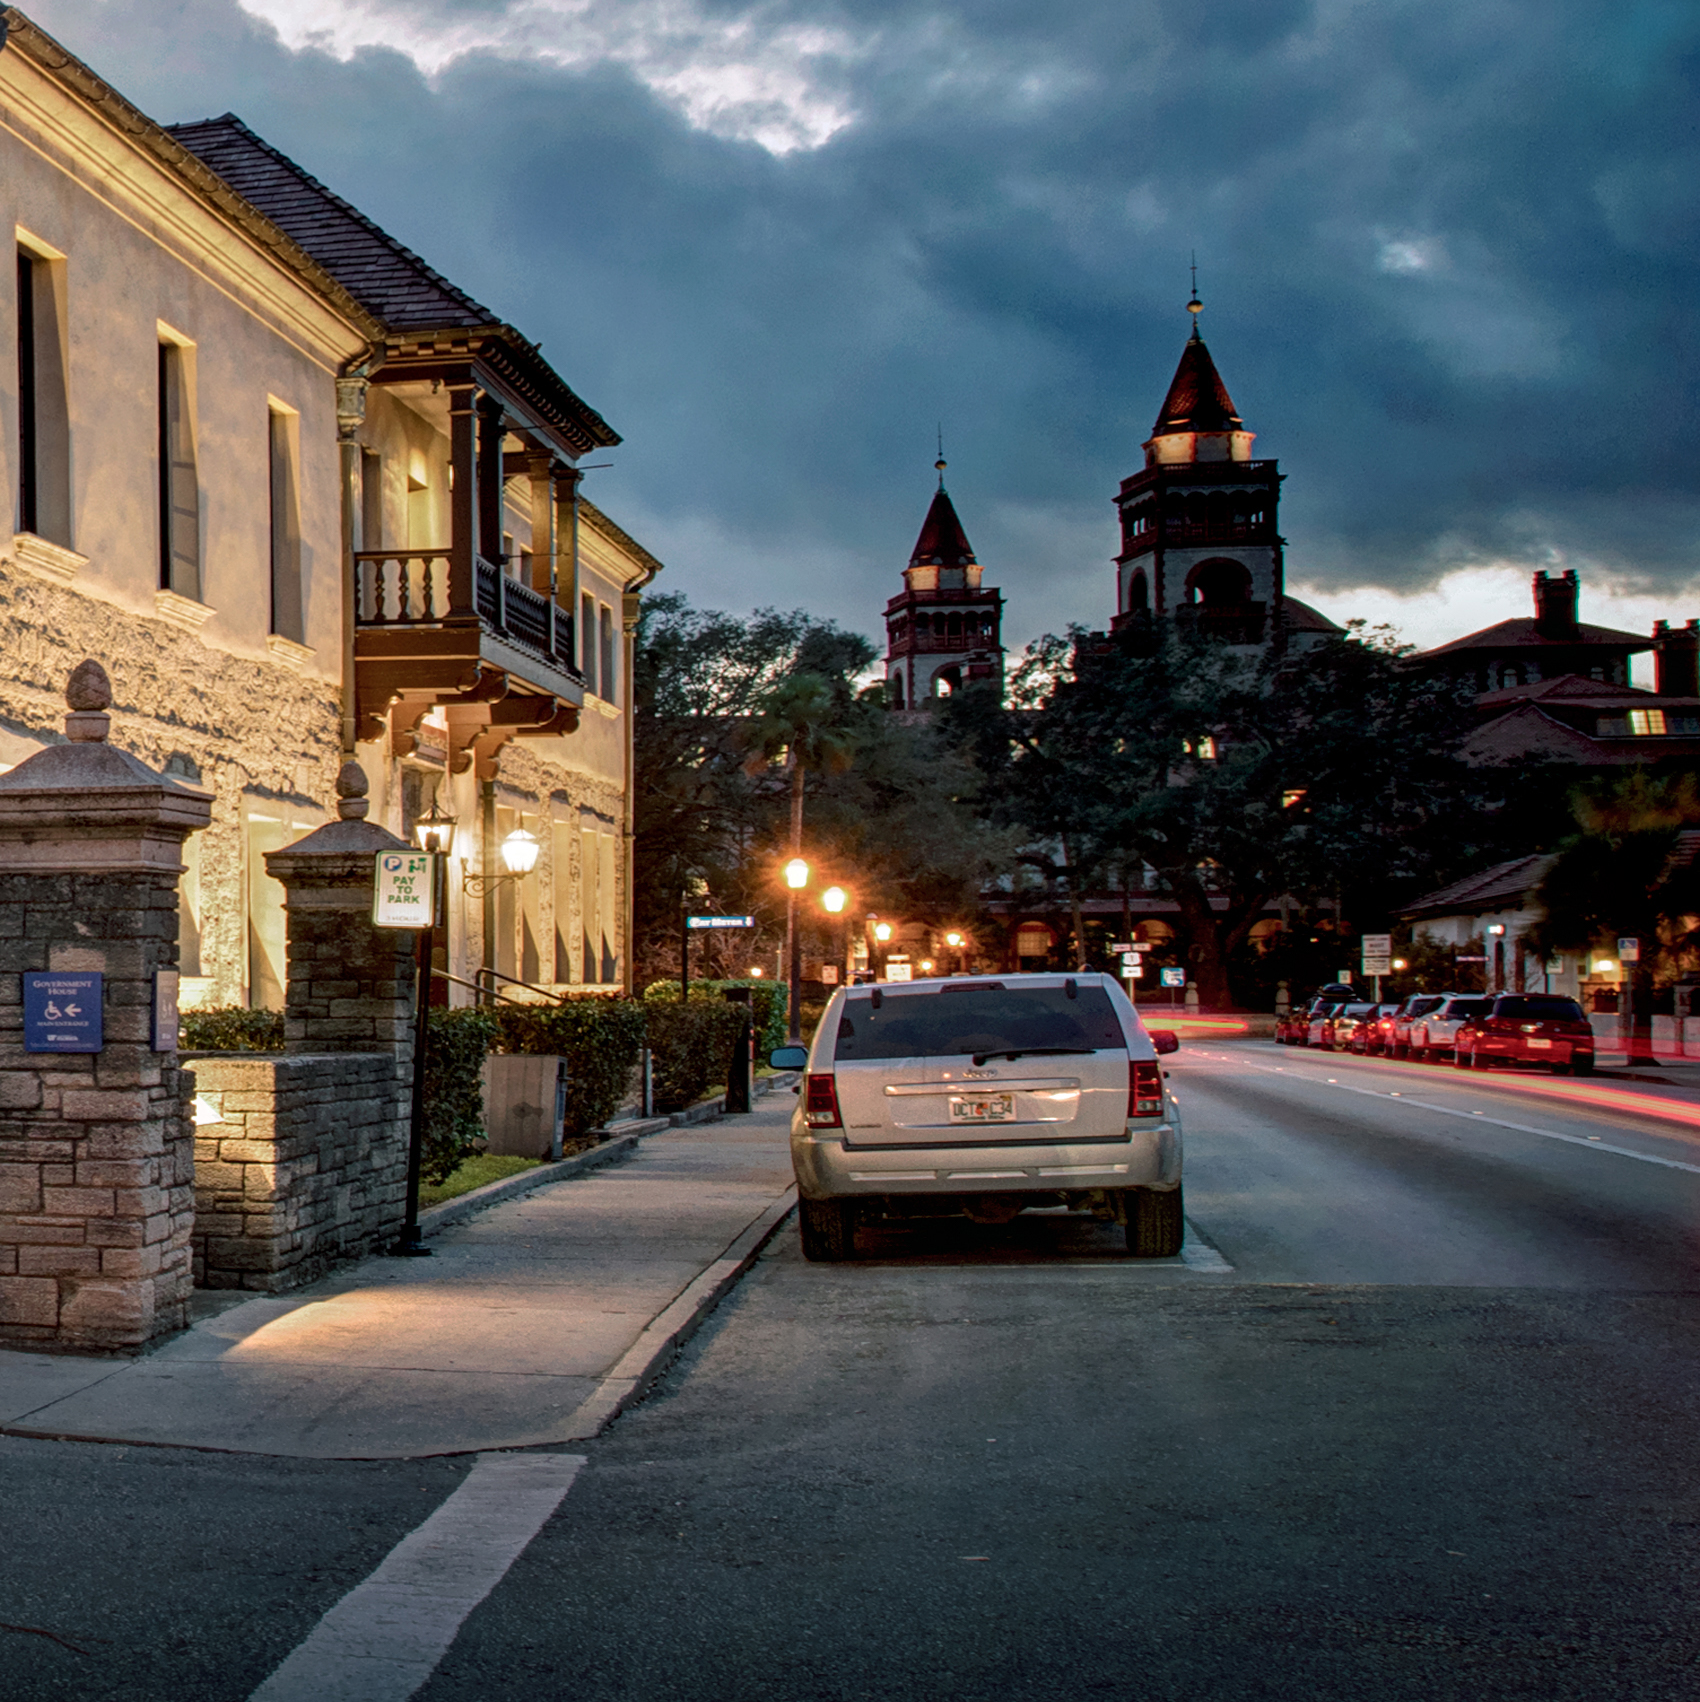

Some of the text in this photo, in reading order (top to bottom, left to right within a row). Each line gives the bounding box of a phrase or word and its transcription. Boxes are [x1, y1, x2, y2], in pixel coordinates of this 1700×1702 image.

[393, 876, 416, 885] PAY
[396, 885, 413, 894] TO
[387, 895, 420, 904] PARK
